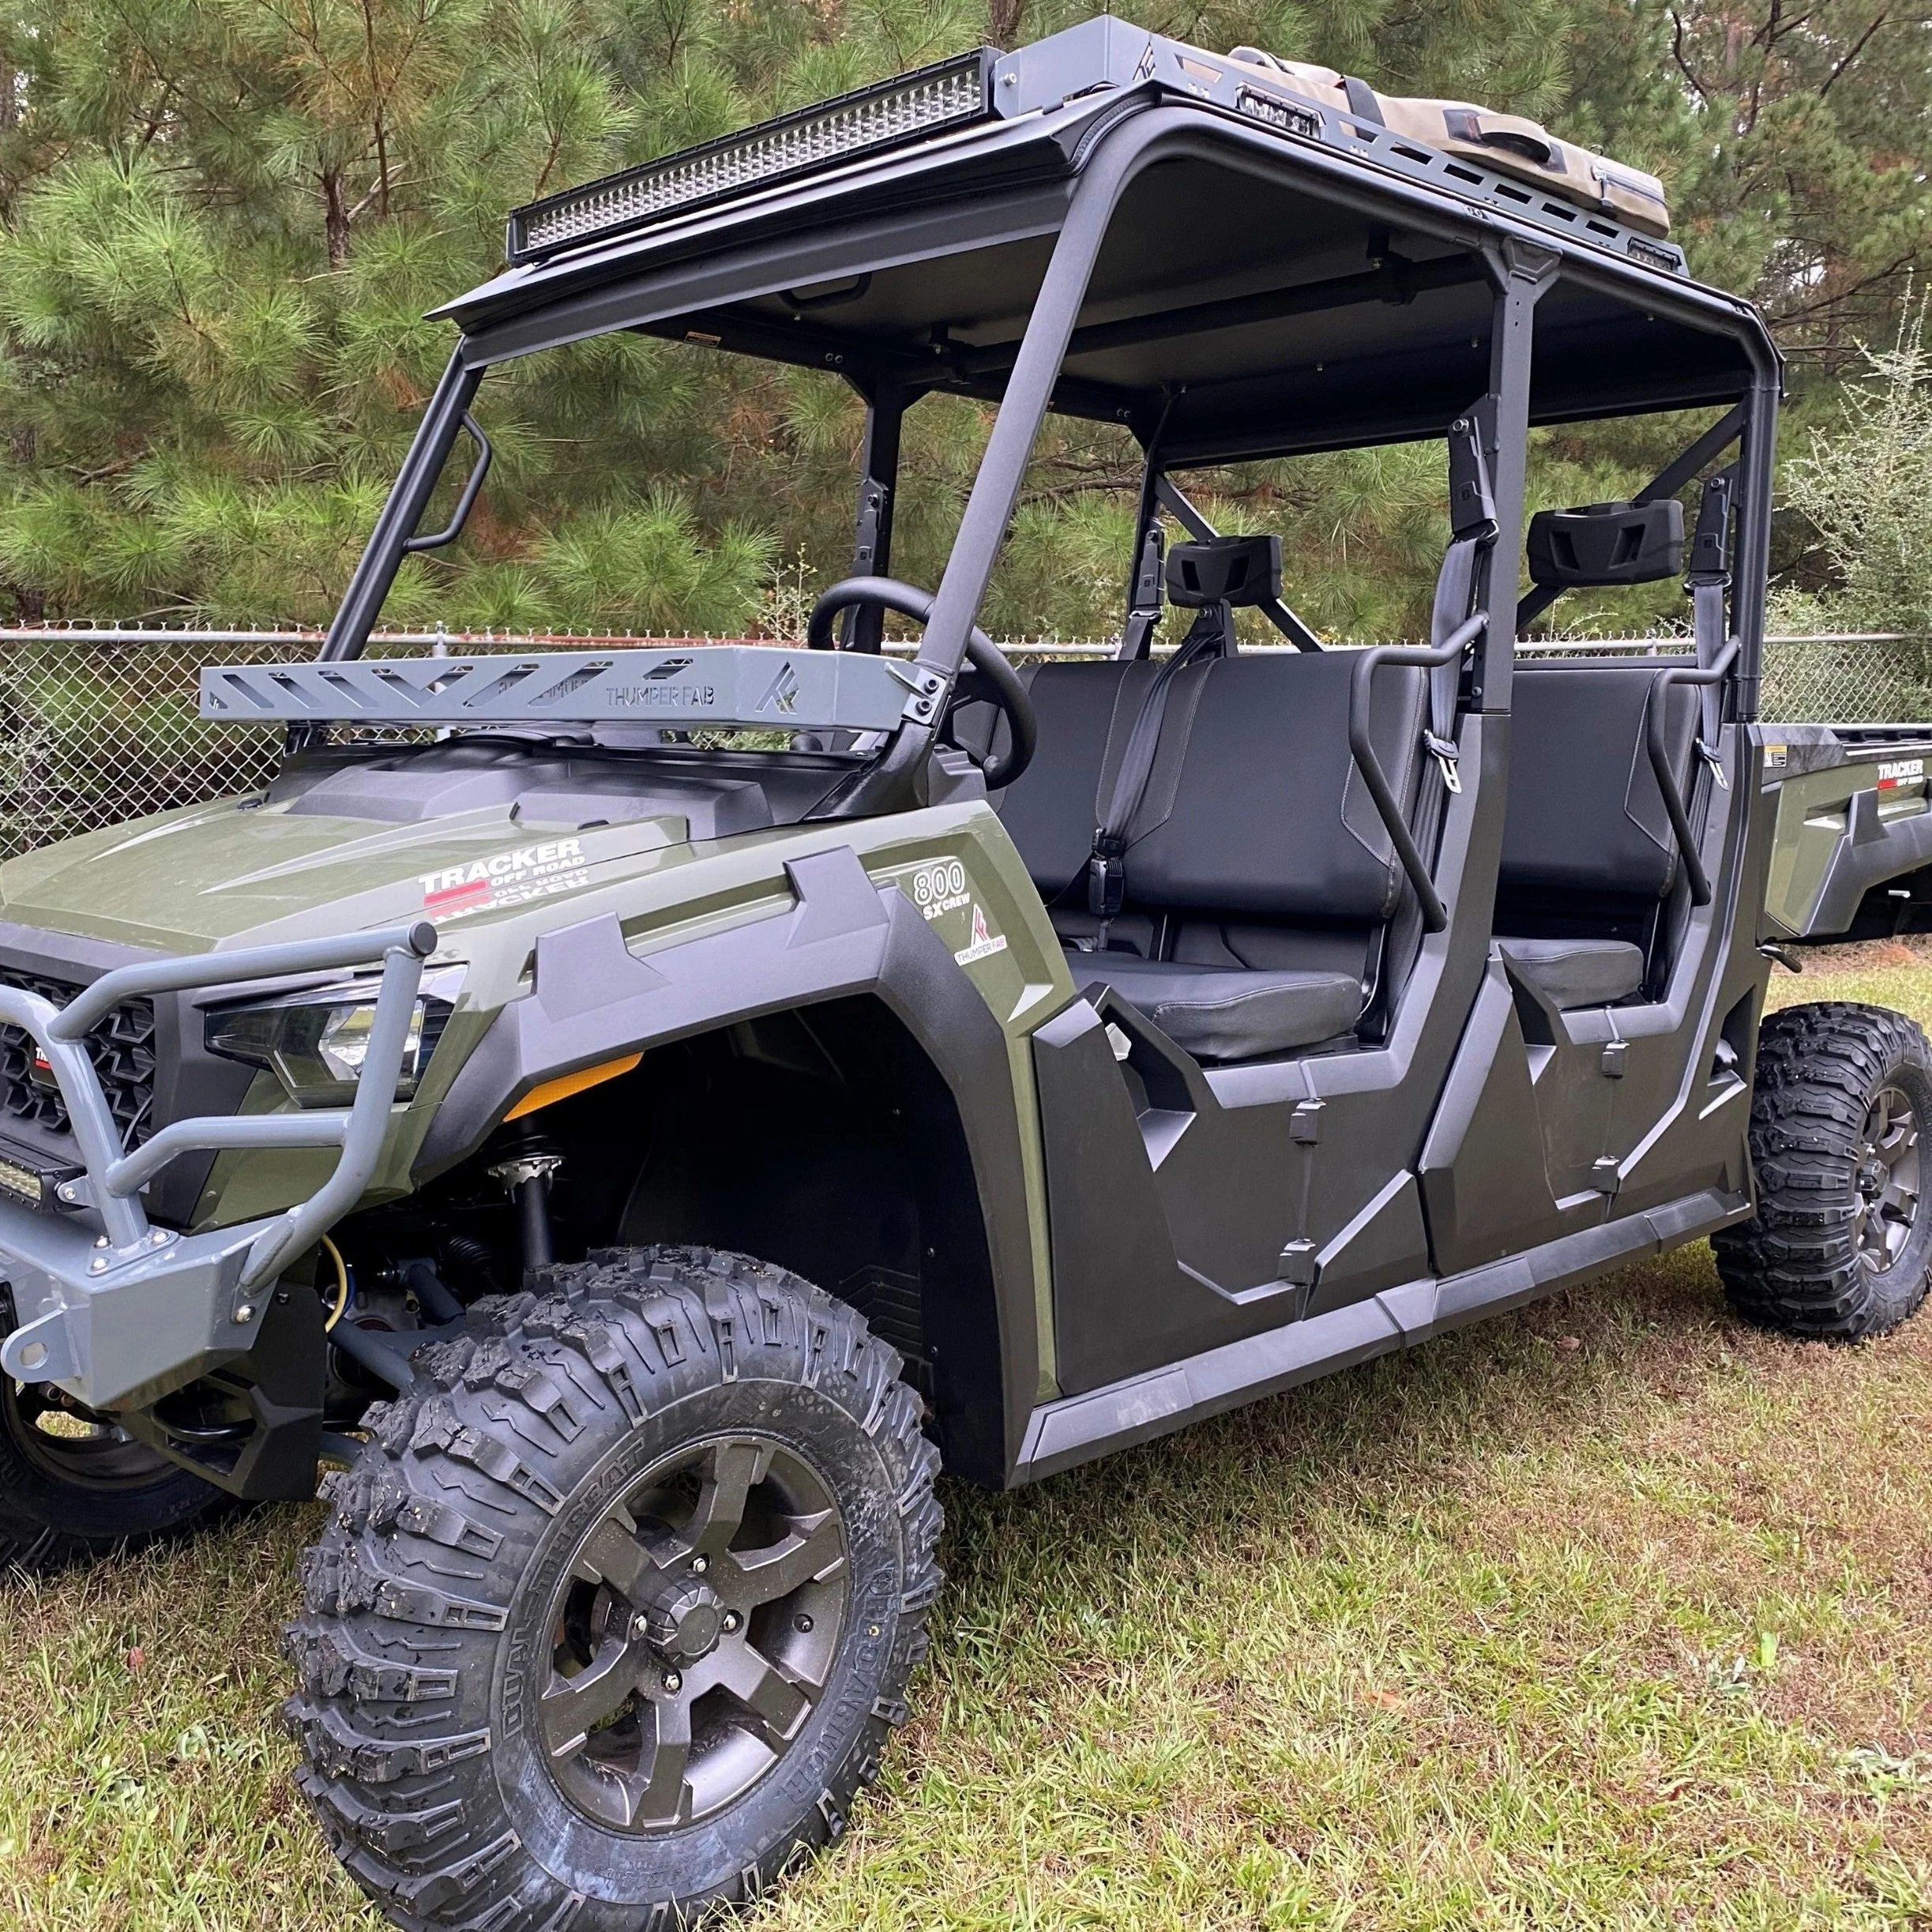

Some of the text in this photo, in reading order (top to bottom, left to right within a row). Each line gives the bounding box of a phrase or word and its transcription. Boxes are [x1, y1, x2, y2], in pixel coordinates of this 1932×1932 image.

[606, 686, 678, 708] THUMPER
[682, 686, 715, 707] FAB
[1877, 759, 1924, 780] TRACKER
[417, 838, 584, 894] TRACKER
[490, 855, 585, 888] OFF ROAD
[913, 861, 965, 906] 800
[957, 943, 992, 964] THUMPER
